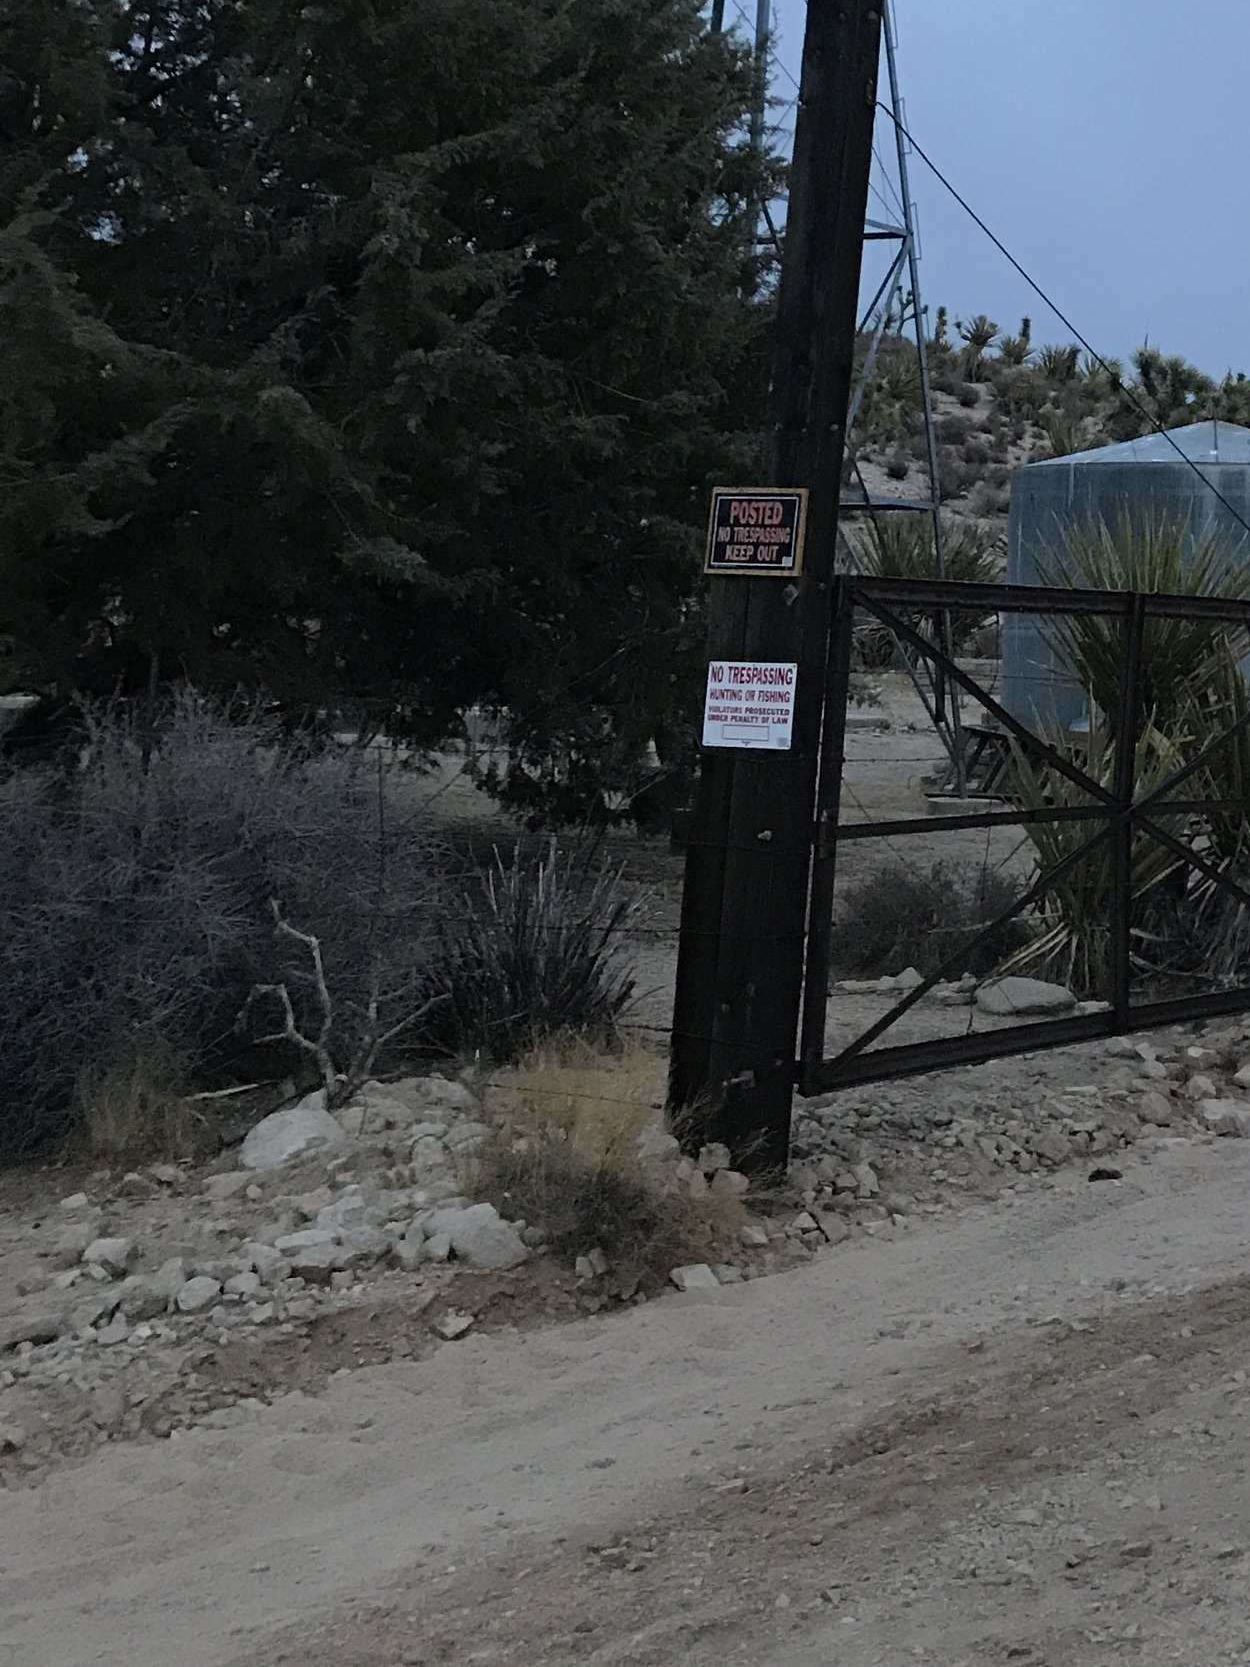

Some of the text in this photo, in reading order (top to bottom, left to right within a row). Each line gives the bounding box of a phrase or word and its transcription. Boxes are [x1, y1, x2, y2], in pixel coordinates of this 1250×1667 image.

[729, 501, 784, 525] POSTED
[717, 526, 791, 544] NO TRESPASSING
[724, 545, 780, 562] KEEP OUT
[710, 665, 794, 686] NO TRESPASSING
[709, 688, 791, 703] HUNTING OR FISHING
[745, 706, 790, 716] PROSECUTED
